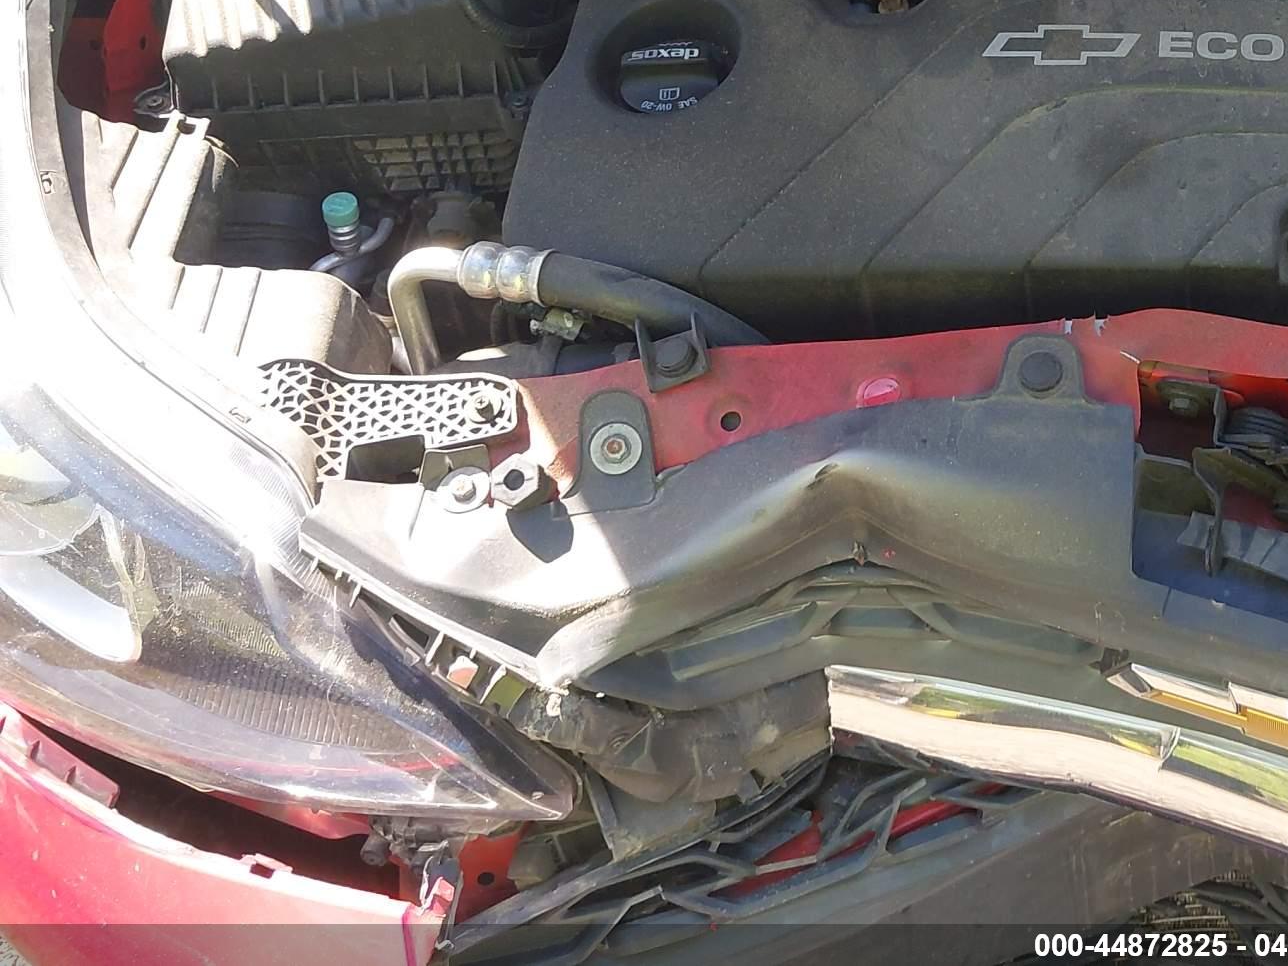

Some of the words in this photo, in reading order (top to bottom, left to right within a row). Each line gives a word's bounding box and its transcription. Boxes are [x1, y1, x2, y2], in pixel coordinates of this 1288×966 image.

[630, 47, 700, 60] dexos
[640, 100, 673, 112] 0W-20
[677, 96, 698, 109] SAE
